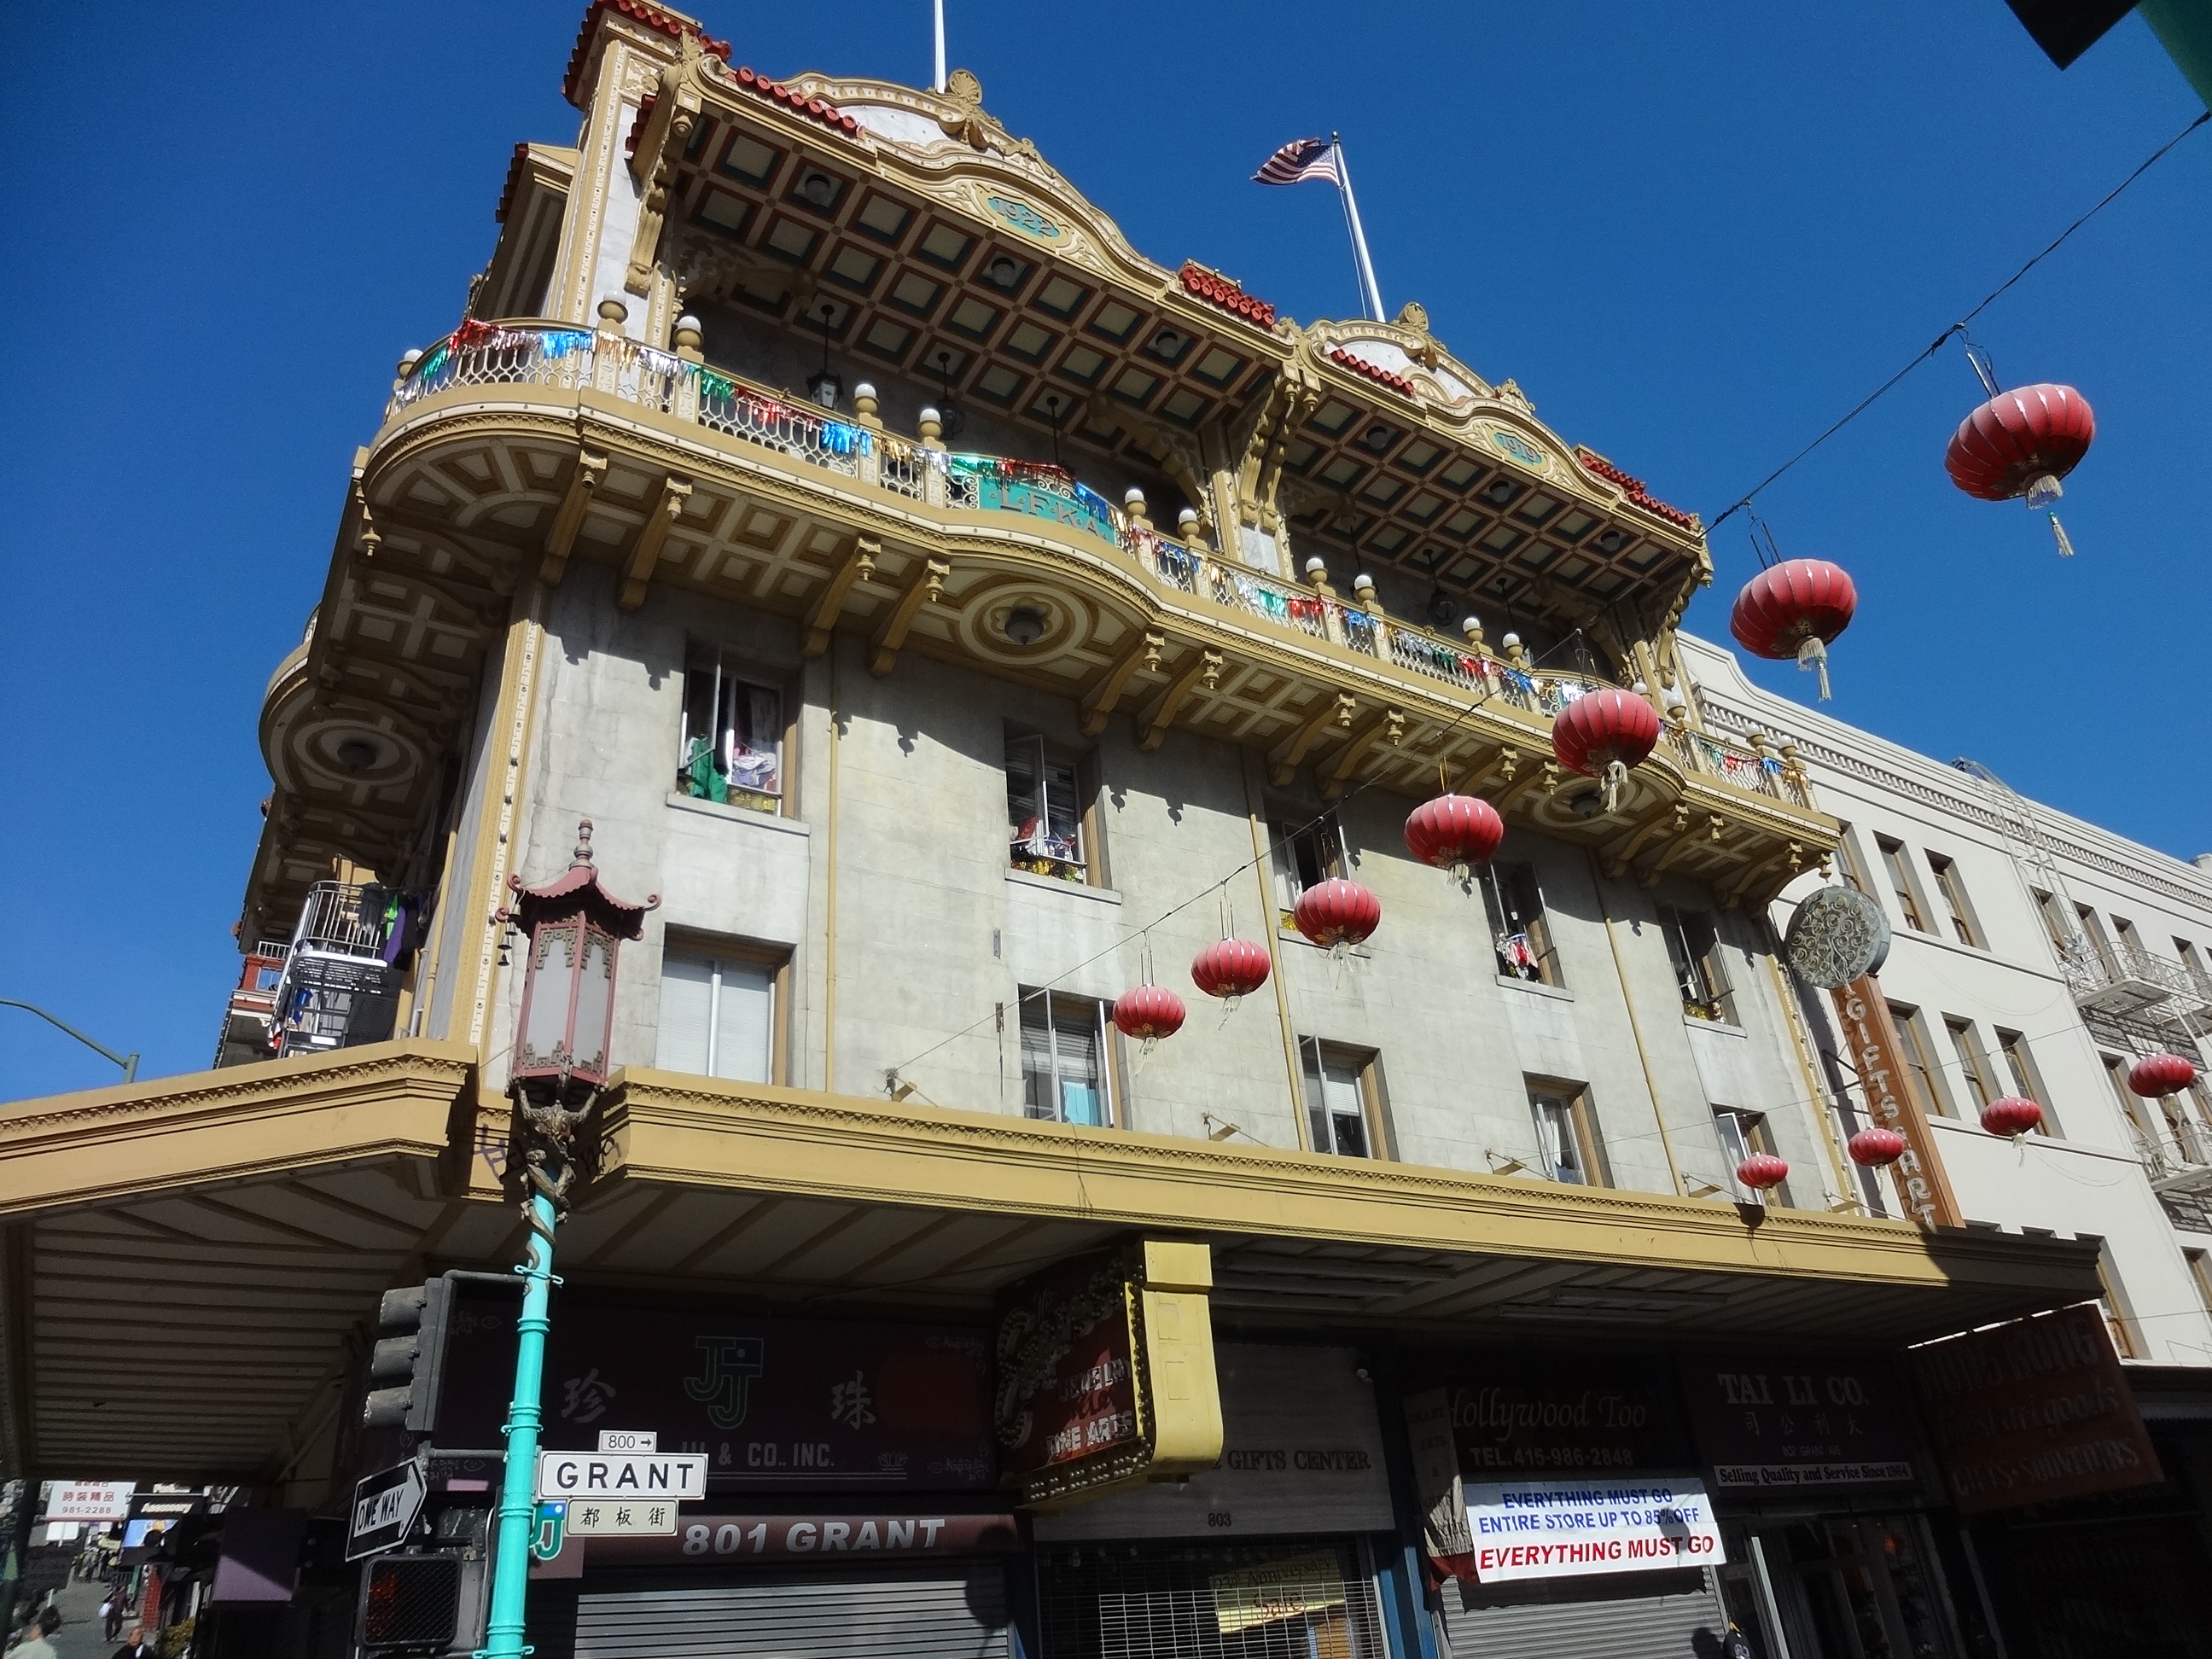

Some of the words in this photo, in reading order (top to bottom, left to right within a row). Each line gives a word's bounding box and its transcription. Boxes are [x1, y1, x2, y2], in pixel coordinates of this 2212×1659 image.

[994, 197, 1054, 238] 1922
[1499, 435, 1538, 463] 1919
[1844, 997, 1901, 1119] GIFTS
[1898, 1148, 1937, 1234] ART
[560, 1367, 616, 1424] 珍
[830, 1370, 876, 1430] 珠
[1717, 1373, 1774, 1405] TAI
[1783, 1375, 1819, 1406] LI
[1826, 1376, 1870, 1406] CO.
[1598, 1394, 1646, 1428] Too
[608, 1435, 635, 1448] 800
[718, 1442, 732, 1465] &
[794, 1443, 835, 1467] INC.
[1227, 1450, 1287, 1470] GIFTS
[1293, 1450, 1371, 1470] CENTER
[556, 1462, 694, 1490] GRANT
[1719, 1467, 1760, 1485] Selling
[1761, 1466, 1801, 1483] Quality
[1803, 1467, 1822, 1481] and
[1824, 1465, 1860, 1480] Service
[1861, 1464, 1885, 1478] Since
[358, 1499, 379, 1531] ONE
[380, 1487, 405, 1523] WAY
[1502, 1490, 1604, 1509] EVERYTHING
[1609, 1488, 1648, 1505] MUST
[1650, 1487, 1673, 1504] GO
[580, 1507, 666, 1528] 都板街
[1208, 1511, 1231, 1528] 803
[1478, 1514, 1540, 1534] ENTIRE
[1545, 1511, 1598, 1530] STORE
[1598, 1511, 1617, 1527] UP
[1621, 1510, 1643, 1526] TO
[683, 1522, 767, 1556] 801
[785, 1519, 946, 1553] GRANT
[1480, 1542, 1621, 1570] EVERYTHING
[1628, 1537, 1683, 1558] MUST
[1687, 1535, 1714, 1554] GO
